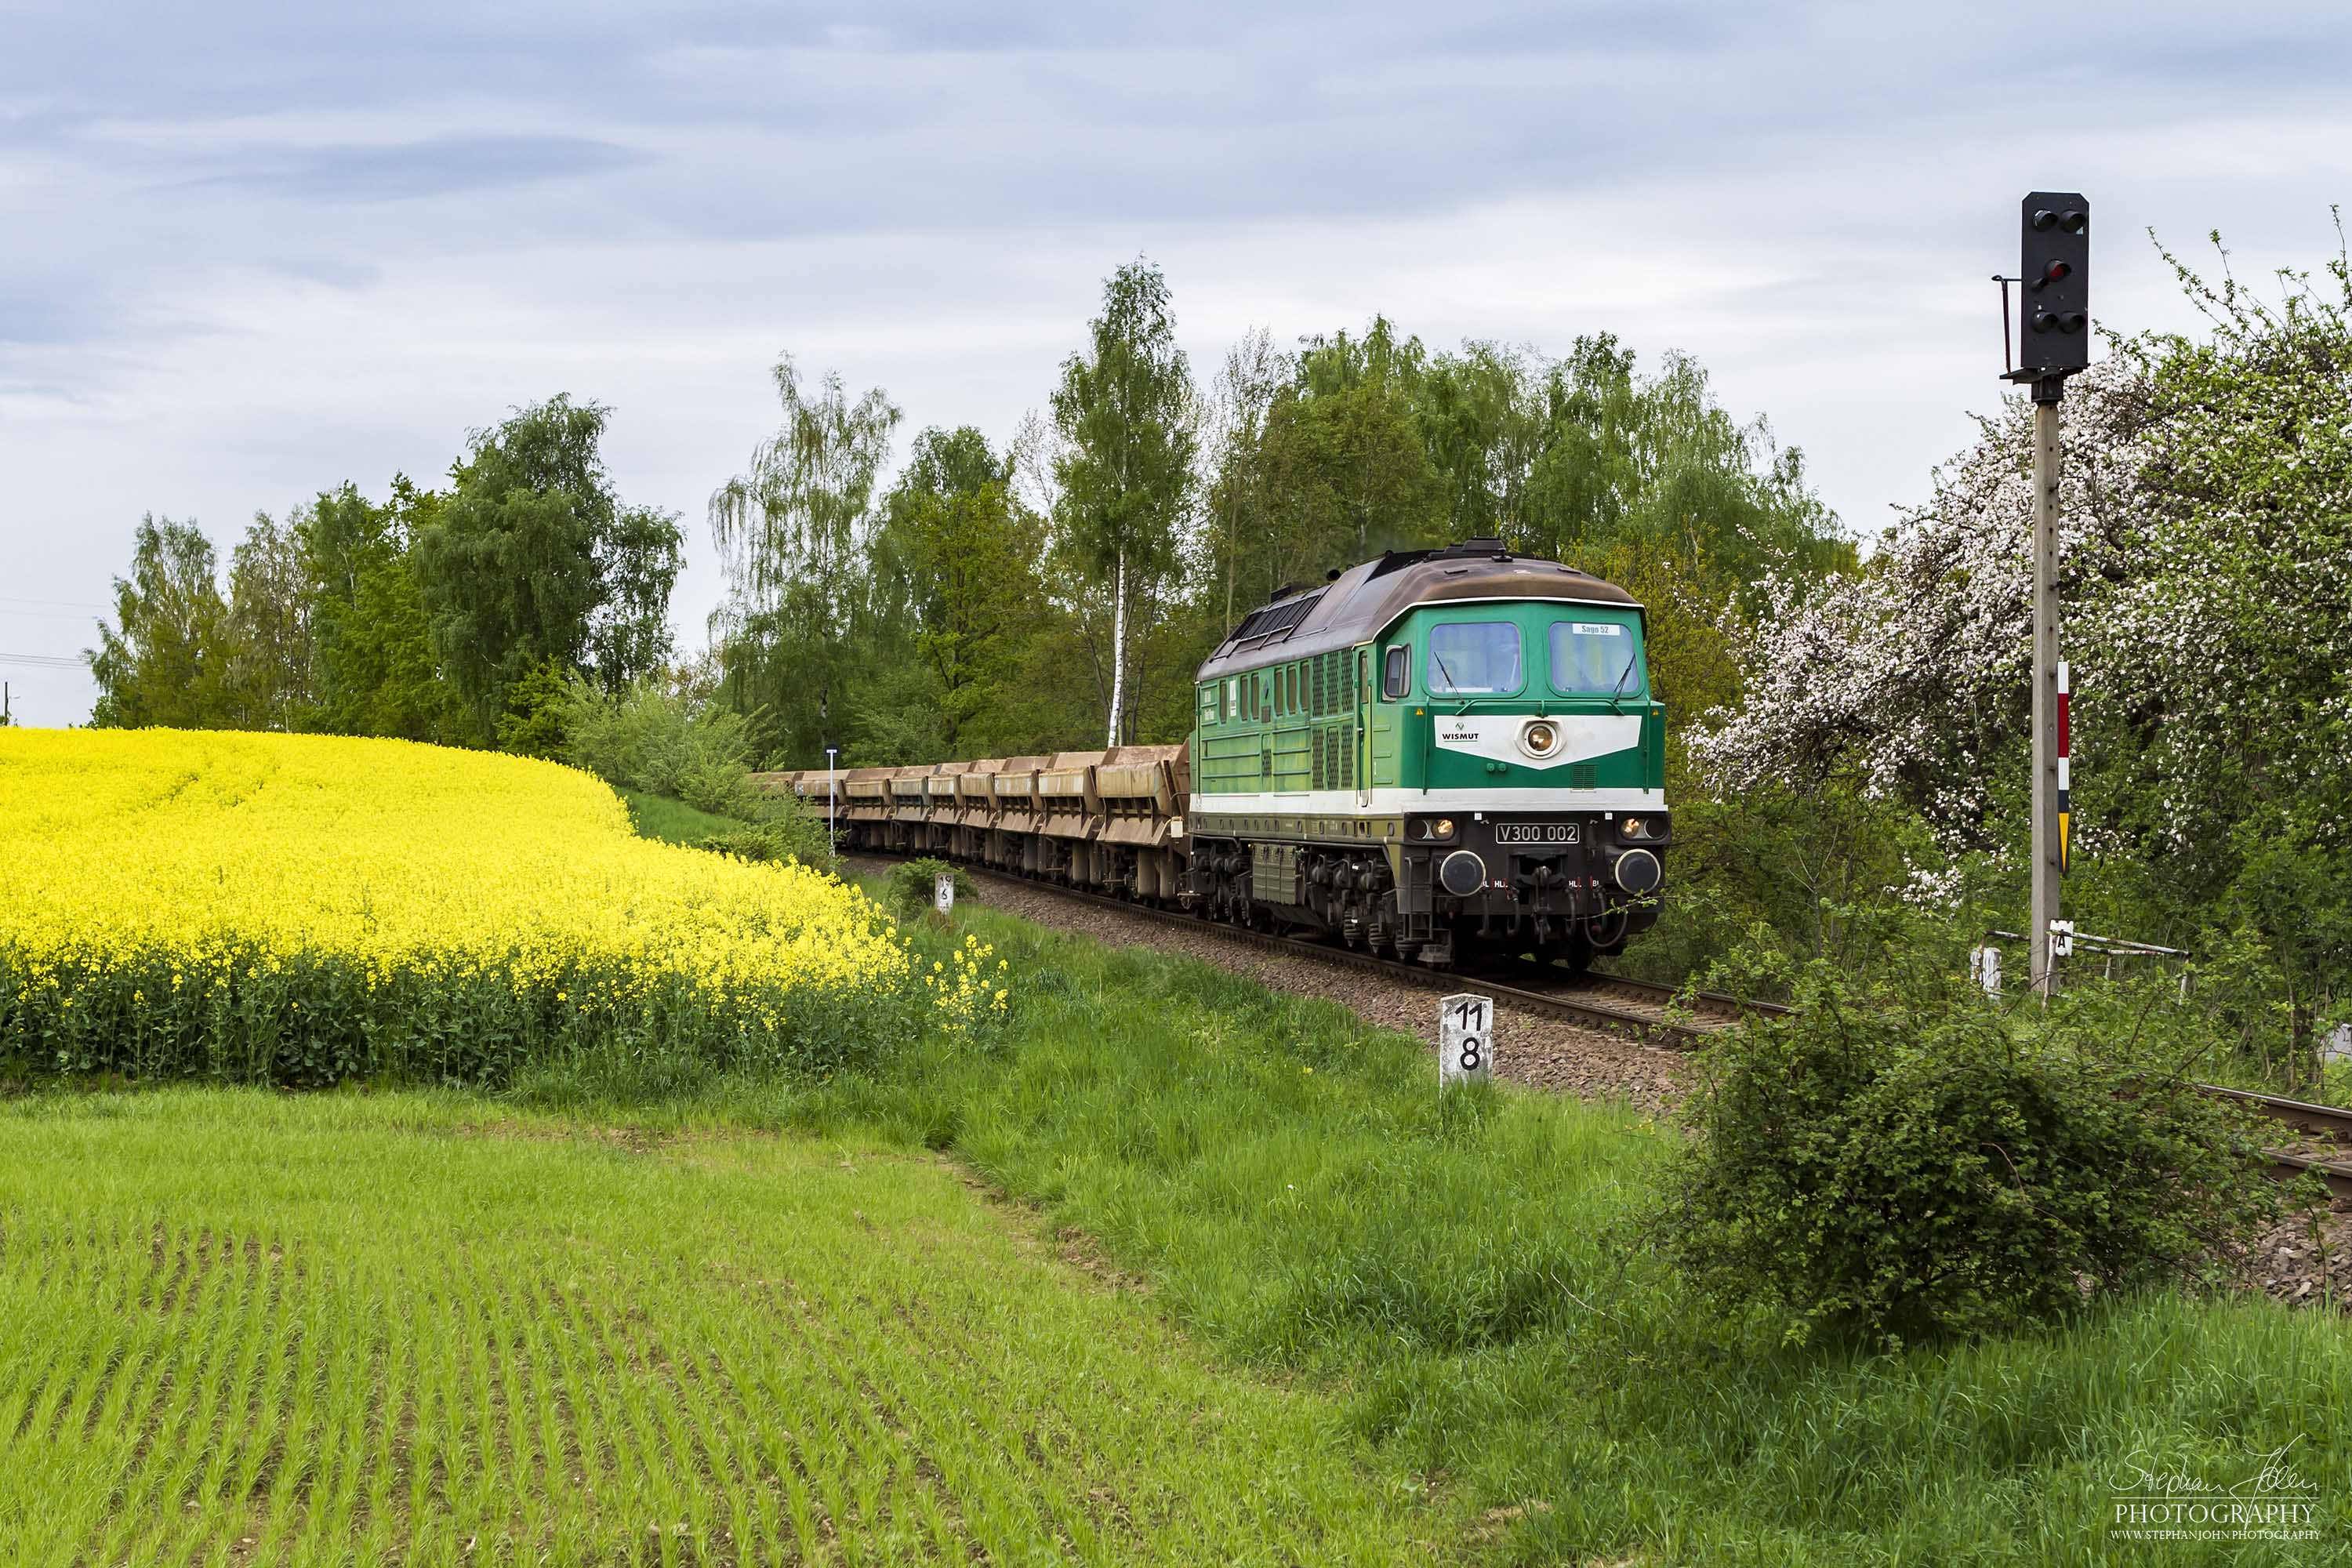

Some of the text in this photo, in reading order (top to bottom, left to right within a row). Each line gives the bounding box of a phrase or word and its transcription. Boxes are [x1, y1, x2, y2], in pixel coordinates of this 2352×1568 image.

[1581, 625, 1609, 634] Sago 52
[1500, 826, 1576, 840] V300 002
[2057, 929, 2066, 947] A
[1455, 1002, 1482, 1031] 11
[1460, 1037, 1480, 1071] 8
